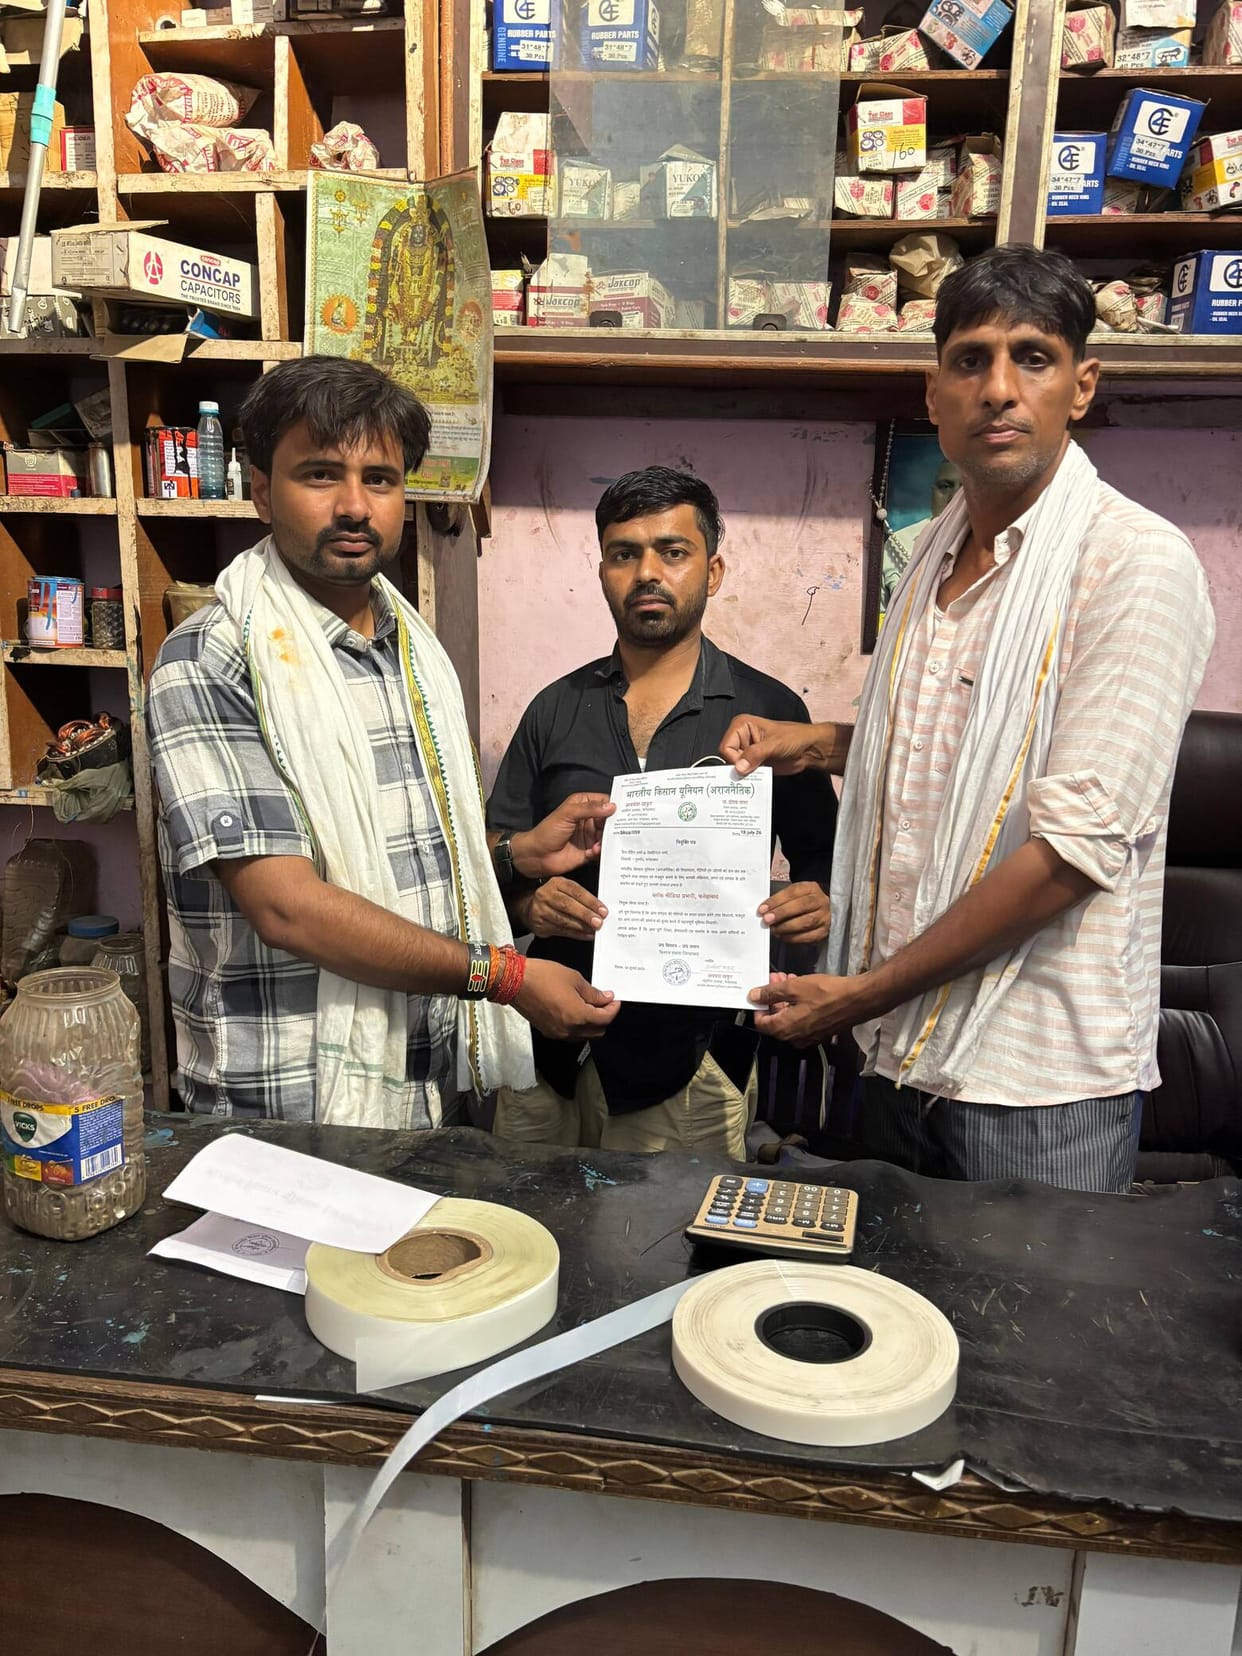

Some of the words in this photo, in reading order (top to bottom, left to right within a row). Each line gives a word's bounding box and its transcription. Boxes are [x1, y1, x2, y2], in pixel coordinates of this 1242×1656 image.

[535, 30, 556, 38] PARTS
[592, 32, 616, 40] RUBBER
[618, 30, 640, 38] PARTS
[497, 26, 507, 63] GENUINE
[180, 260, 240, 287] CONCAP
[180, 280, 241, 304] CAPACITORS
[626, 787, 652, 798] भारतीय
[654, 785, 676, 796] किसान
[679, 784, 704, 799] यूनियन
[706, 782, 755, 798] (अराजनैतिक)
[23, 1102, 44, 1111] DROPS
[82, 1102, 98, 1111] FREE
[16, 1121, 35, 1131] VICKS
